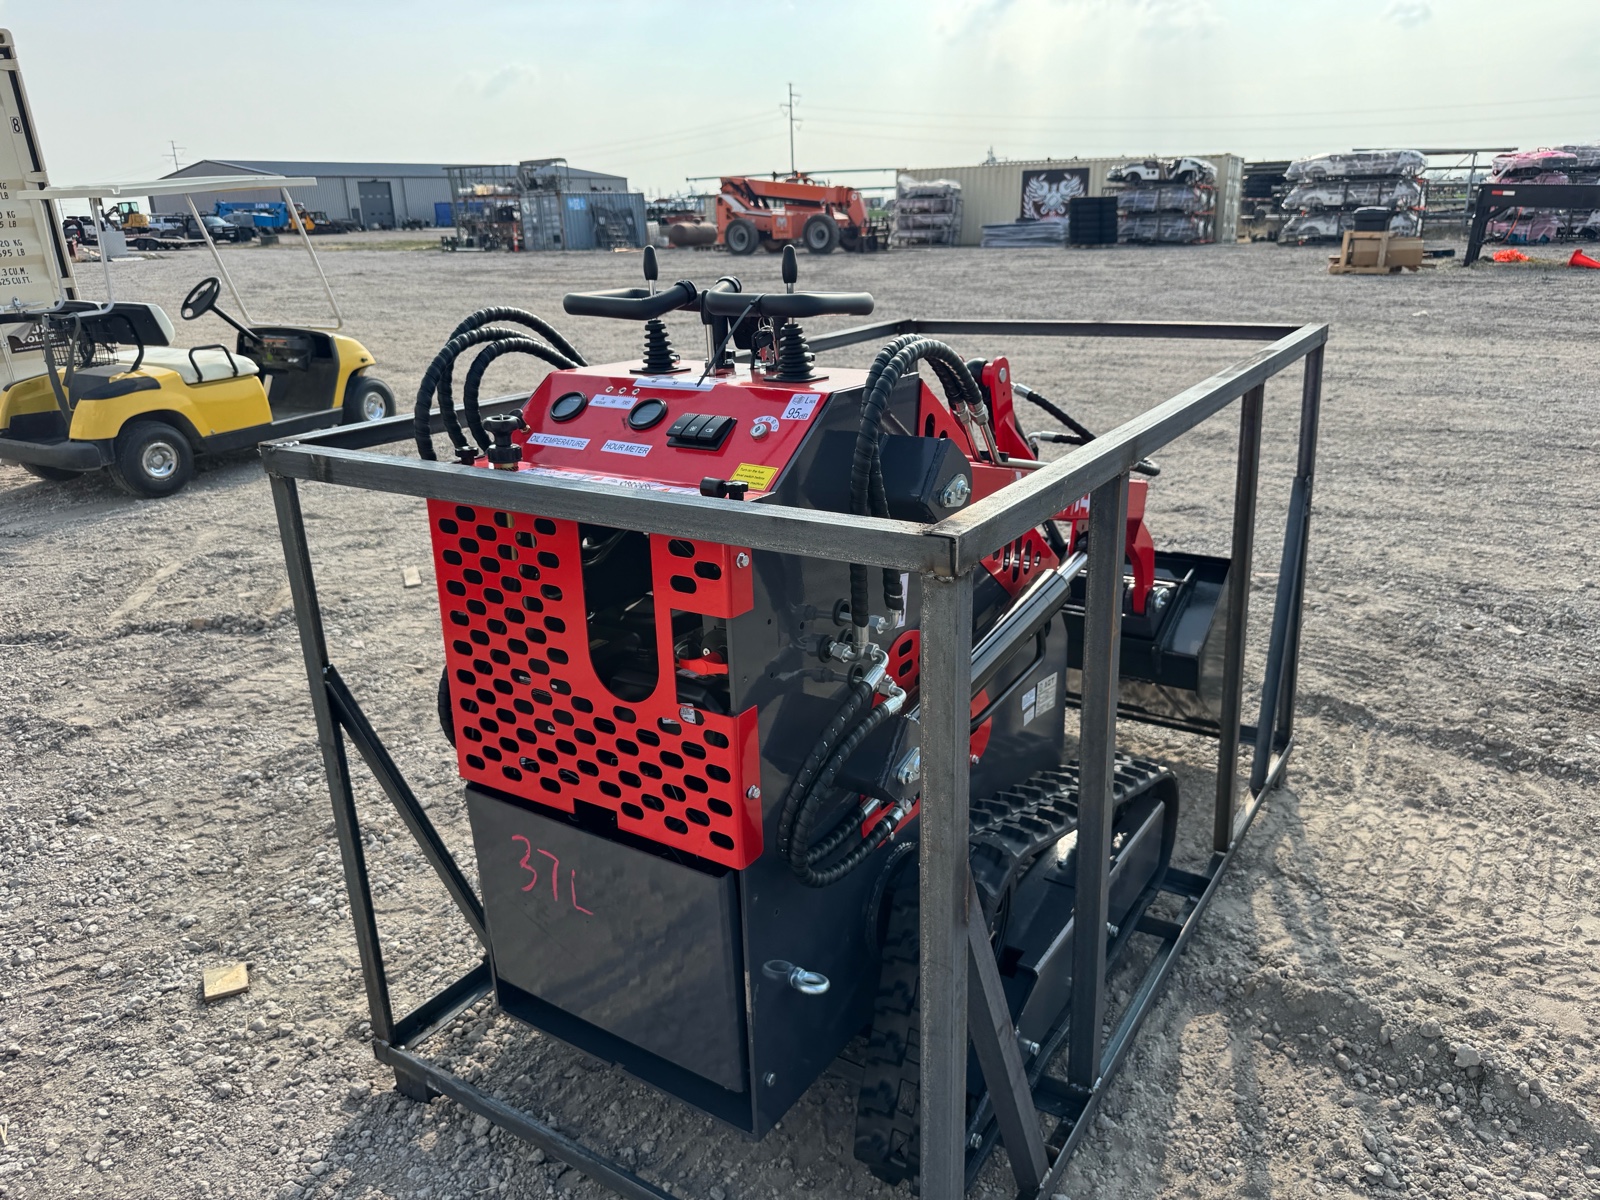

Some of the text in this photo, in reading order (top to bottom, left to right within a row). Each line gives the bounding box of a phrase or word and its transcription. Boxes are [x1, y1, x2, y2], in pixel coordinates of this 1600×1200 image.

[12, 117, 21, 133] 8
[6, 210, 16, 219] KG
[8, 220, 17, 228] LB
[13, 238, 23, 247] KG
[17, 248, 26, 257] LB
[529, 434, 588, 449] OIL TEMPERATURE
[604, 442, 650, 455] HOUR METER
